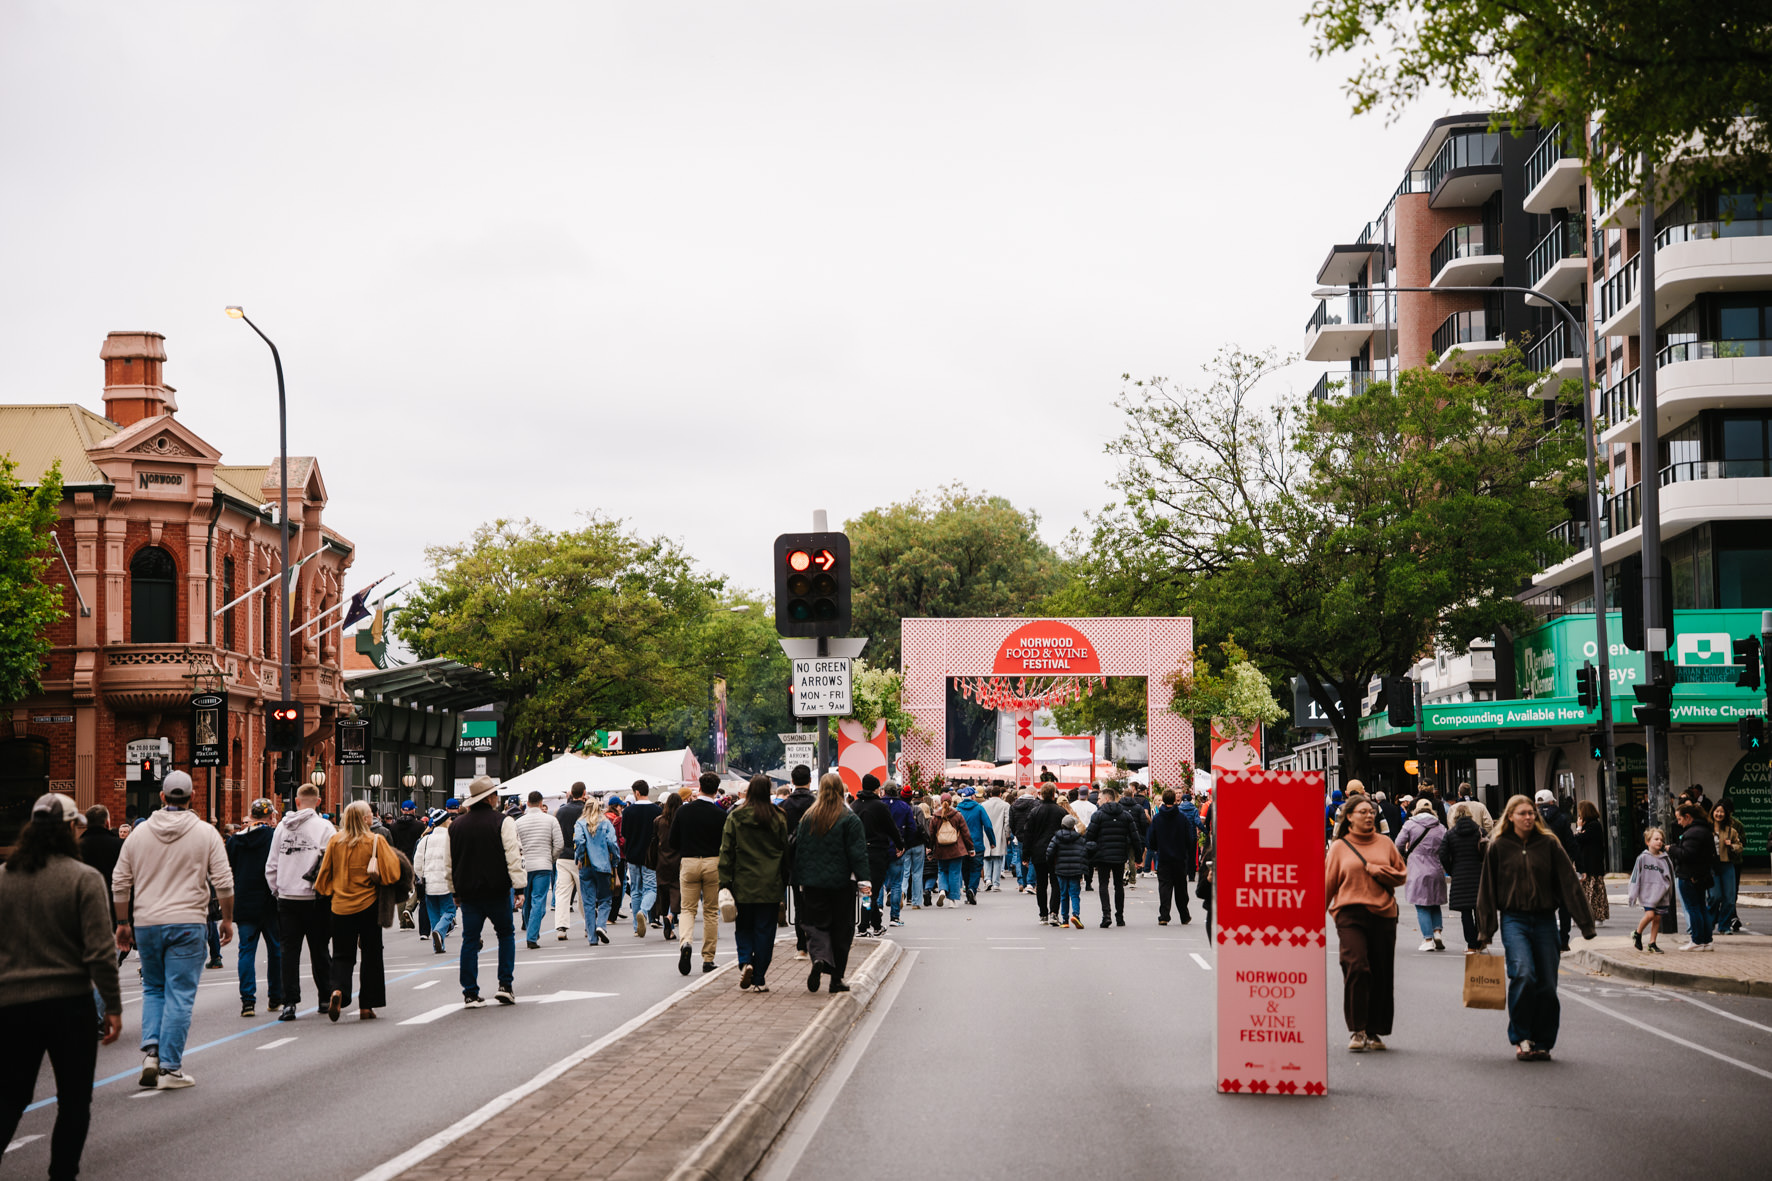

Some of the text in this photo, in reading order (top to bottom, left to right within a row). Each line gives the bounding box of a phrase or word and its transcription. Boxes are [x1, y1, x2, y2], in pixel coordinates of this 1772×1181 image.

[1020, 637, 1073, 648] NORWOOD
[1583, 641, 1629, 657] Oen
[1006, 648, 1088, 658] FOOD & WINE
[796, 662, 846, 673] NO GREEN
[1023, 659, 1070, 669] FESTIVAL
[801, 676, 843, 686] ARROWS
[800, 691, 820, 700] MON
[830, 691, 844, 699] FRI
[800, 702, 816, 711] 7AM
[828, 702, 844, 710] 9AM
[1432, 708, 1584, 726] Compounding Available Here
[1244, 863, 1298, 884] FREE
[1236, 888, 1306, 908] ENTRY
[1236, 971, 1308, 984] NORWOOD
[1250, 985, 1295, 998] FOOD
[1266, 1000, 1279, 1013] &
[1250, 1015, 1296, 1028] WINE
[1240, 1030, 1304, 1043] FESTIVAL
